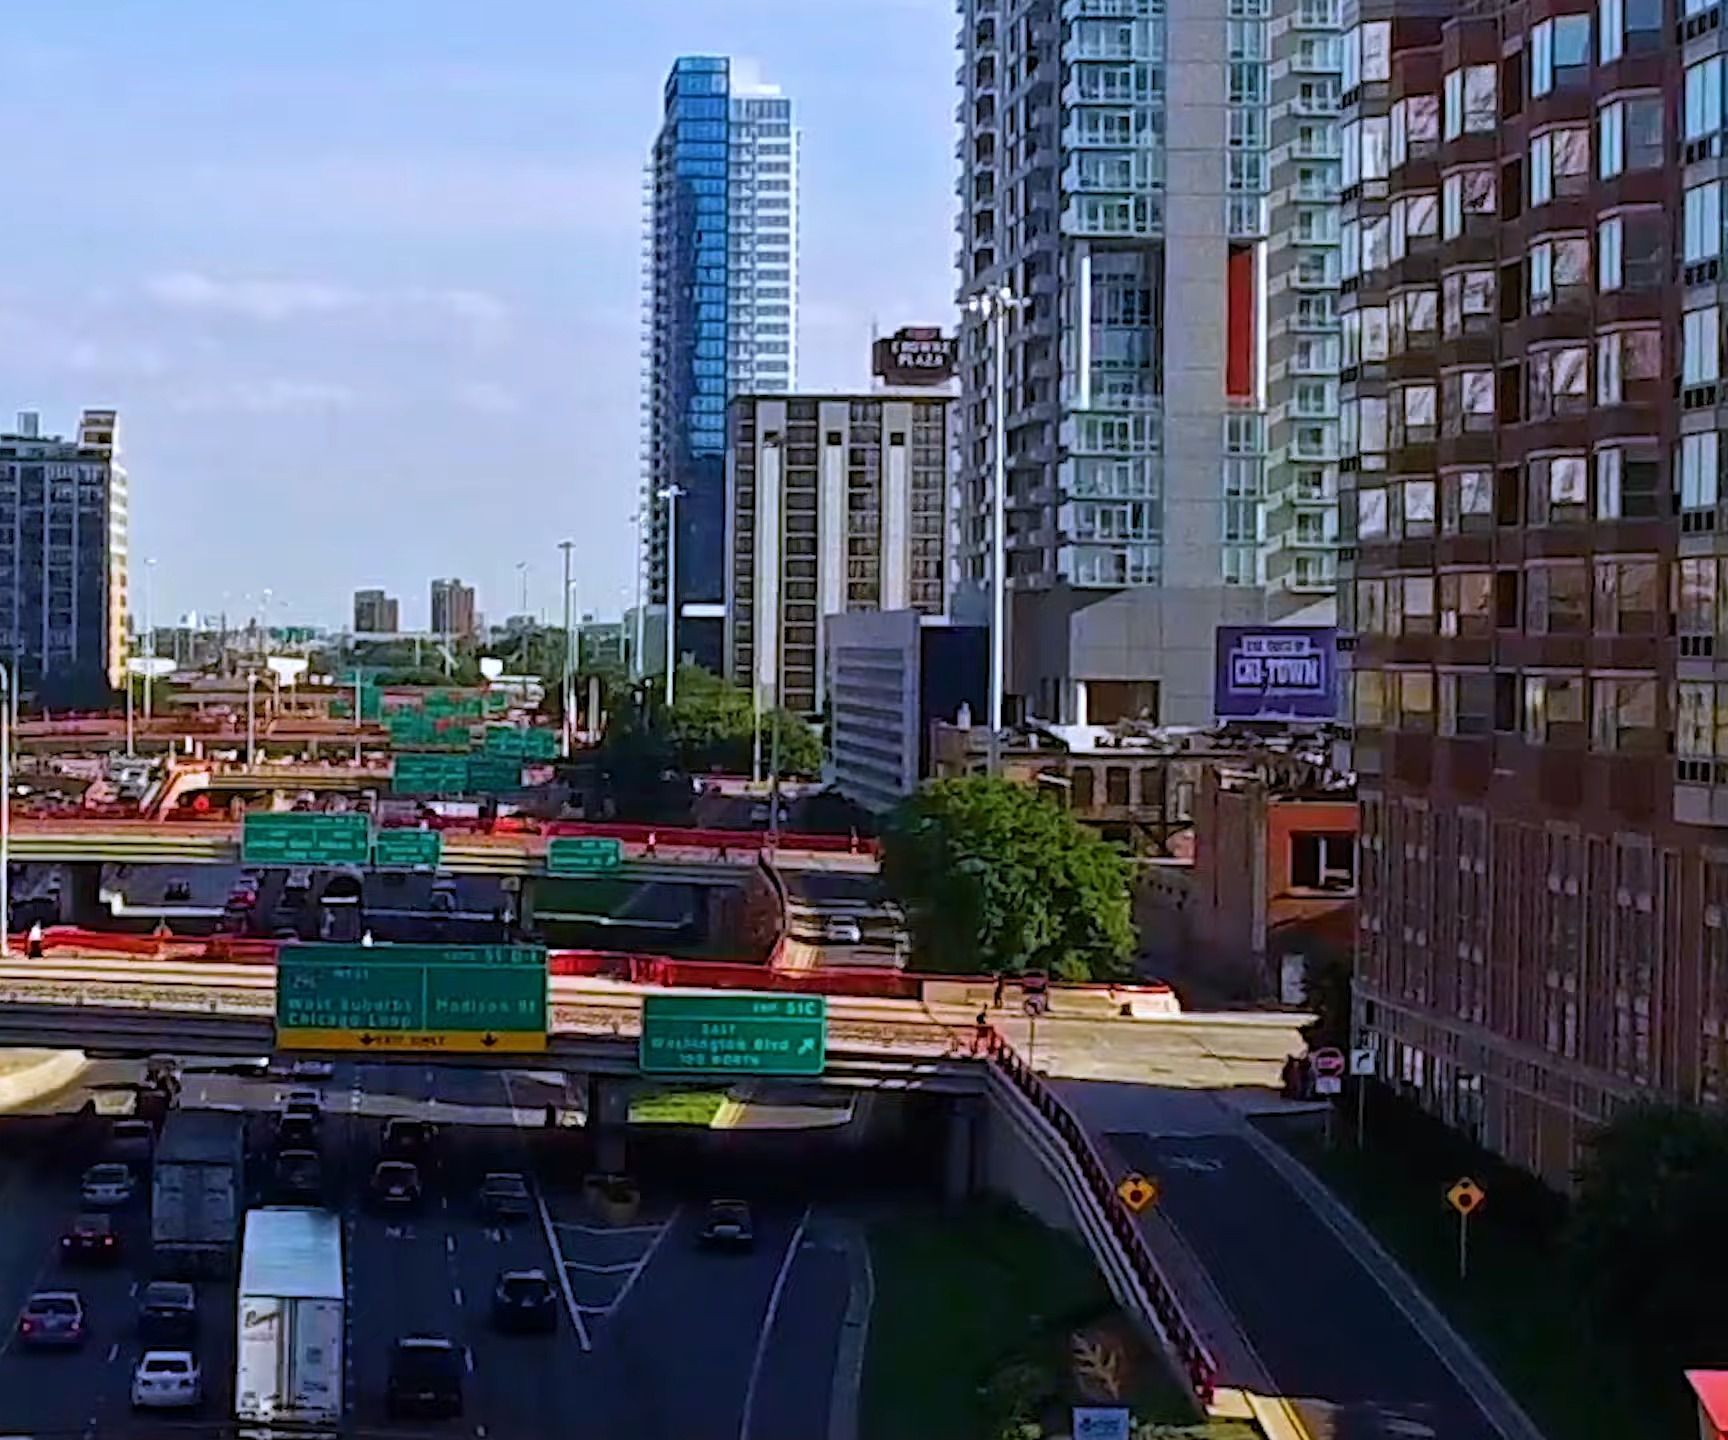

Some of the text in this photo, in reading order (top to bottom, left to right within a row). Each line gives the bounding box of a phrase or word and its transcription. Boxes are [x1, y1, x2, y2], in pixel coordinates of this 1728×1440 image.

[898, 353, 943, 368] PLAZA
[785, 1001, 817, 1015] 51C
[288, 1012, 360, 1027] Chicago
[753, 1038, 790, 1052] Blvd
